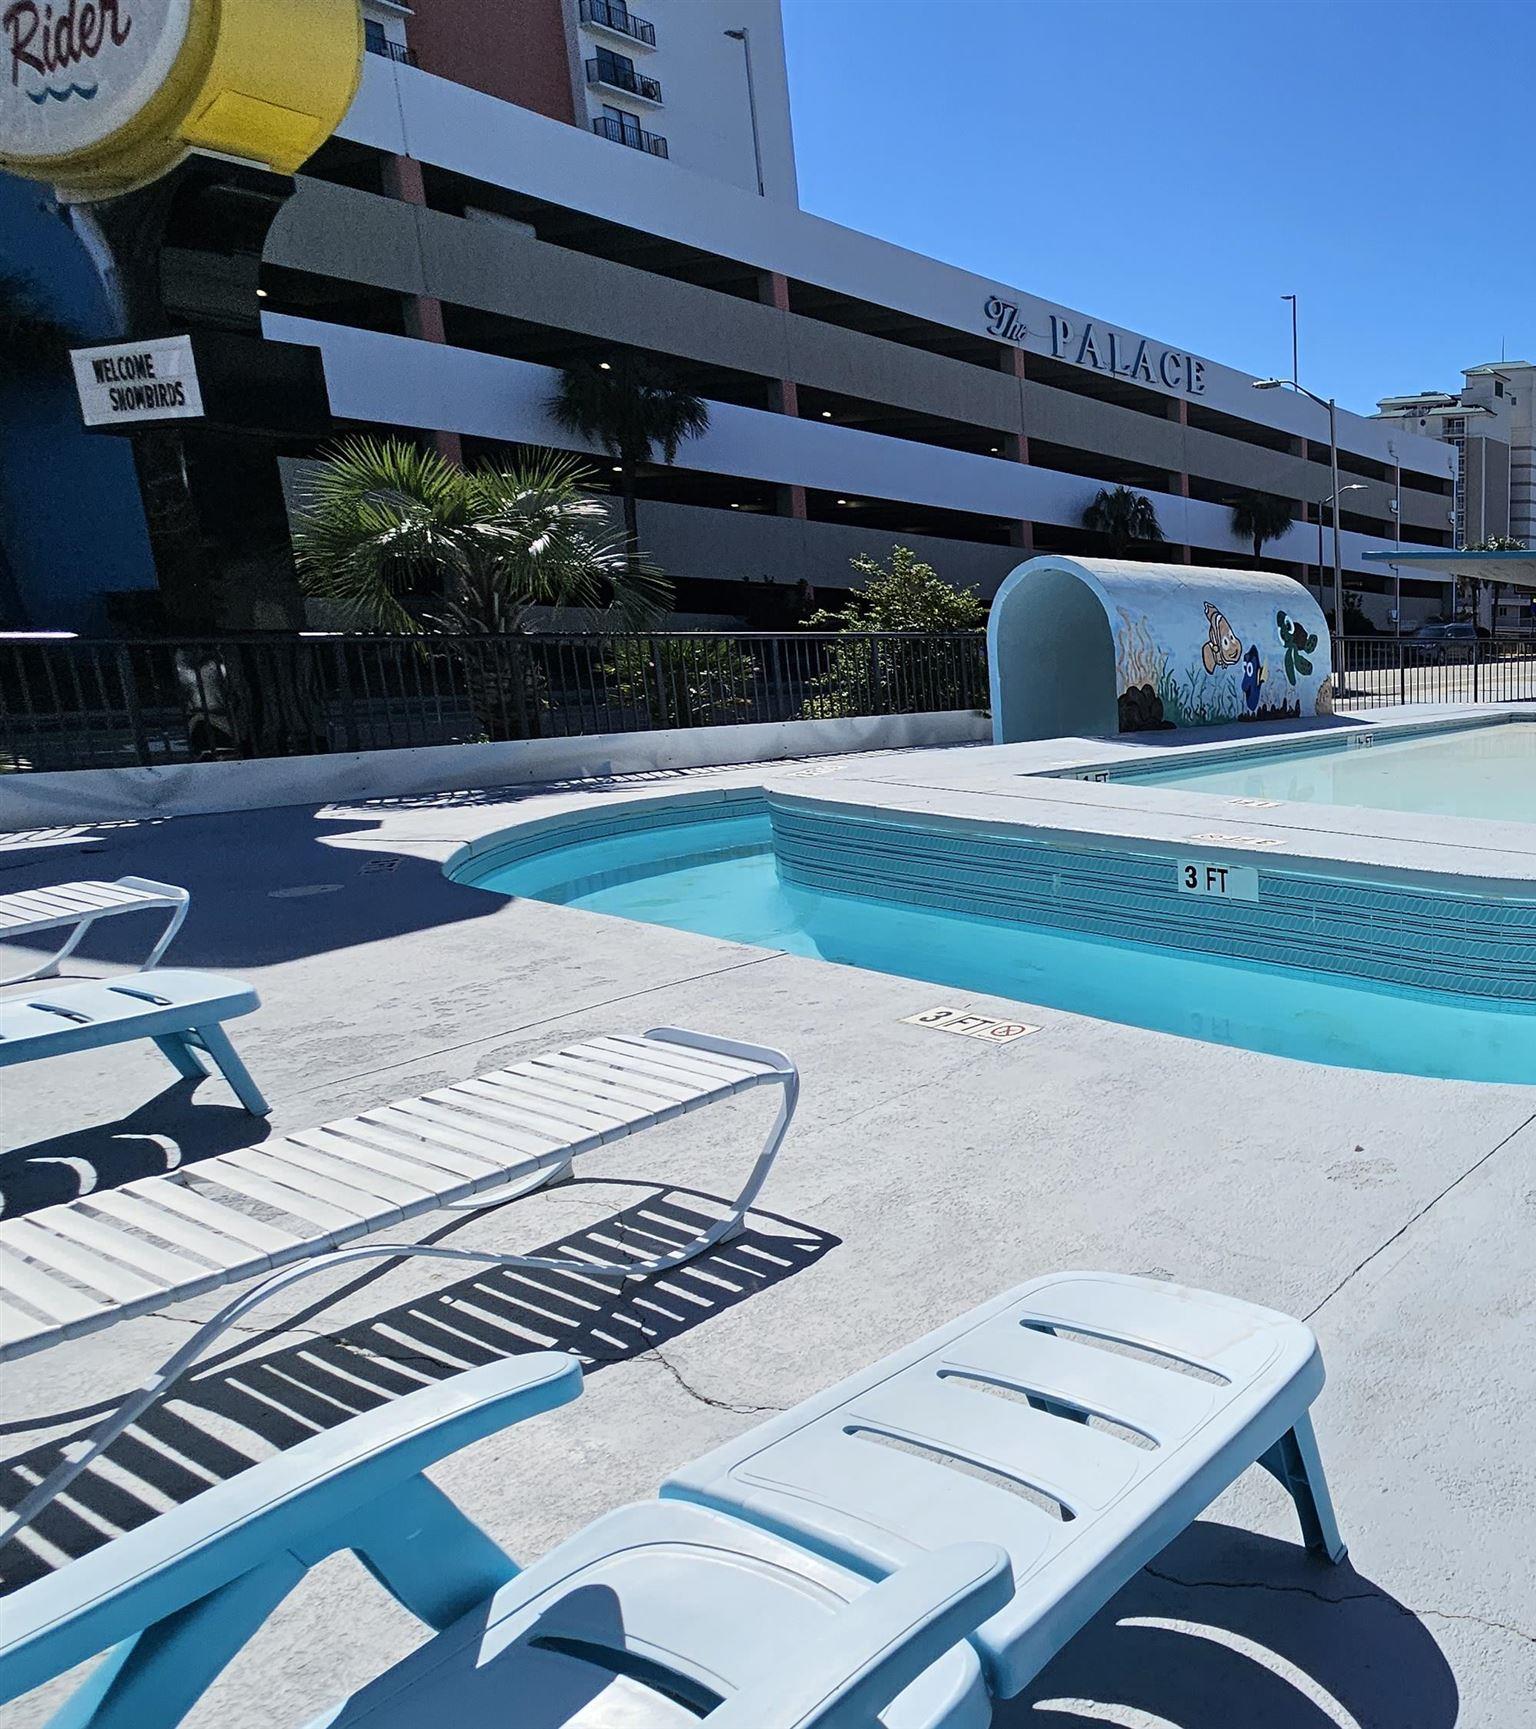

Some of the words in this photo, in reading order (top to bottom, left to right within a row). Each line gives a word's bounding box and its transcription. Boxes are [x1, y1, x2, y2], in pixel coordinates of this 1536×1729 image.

[3, 0, 132, 87] Rider
[984, 296, 1027, 341] The
[1049, 315, 1206, 395] PALACE
[92, 354, 156, 384] WELCOME
[109, 381, 185, 411] SNOWBIRDS
[1184, 865, 1198, 889] 3
[1206, 866, 1229, 893] FT
[919, 1010, 953, 1023] 3
[944, 1016, 995, 1032] FT
